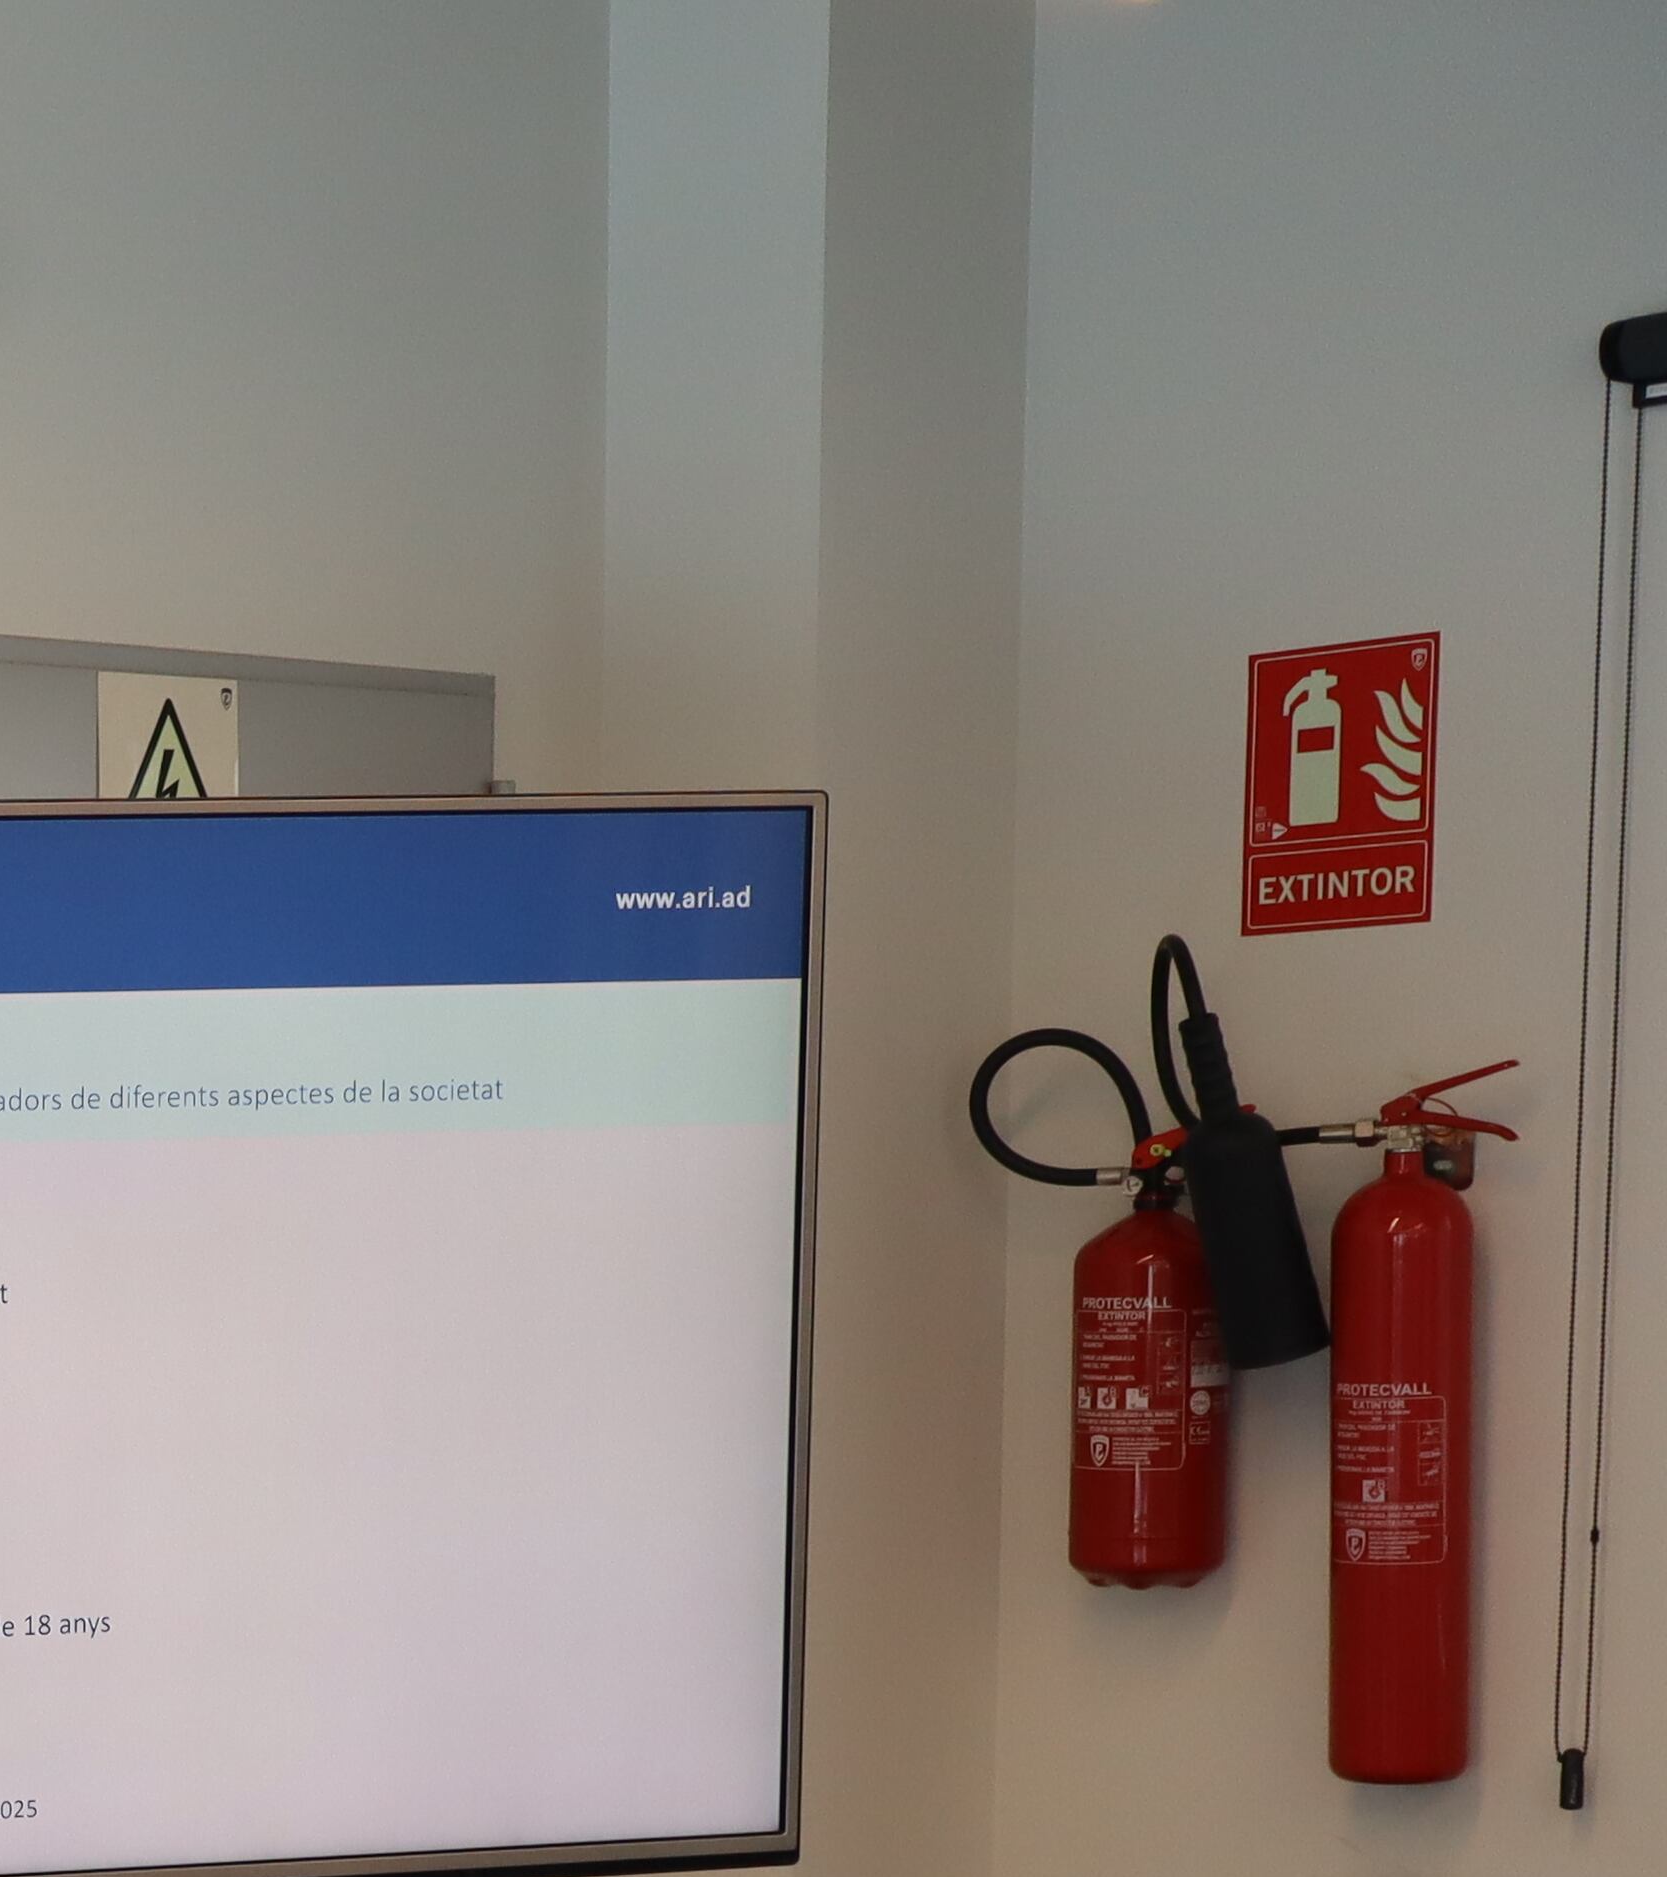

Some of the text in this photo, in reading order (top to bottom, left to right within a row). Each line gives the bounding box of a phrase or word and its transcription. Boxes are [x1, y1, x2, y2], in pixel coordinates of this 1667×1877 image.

[1259, 866, 1414, 904] EXTINTOR
[616, 885, 750, 909] www.ari.ad
[71, 1086, 100, 1109] de
[110, 1084, 219, 1109] diferents
[228, 1085, 334, 1110] aspectes
[343, 1080, 372, 1103] de
[382, 1079, 399, 1102] la
[410, 1079, 502, 1102] societat
[1083, 1296, 1172, 1309] PROTECVALL
[1337, 1382, 1432, 1396] PROTECVALL
[25, 1615, 51, 1635] 18
[60, 1617, 110, 1638] anys
